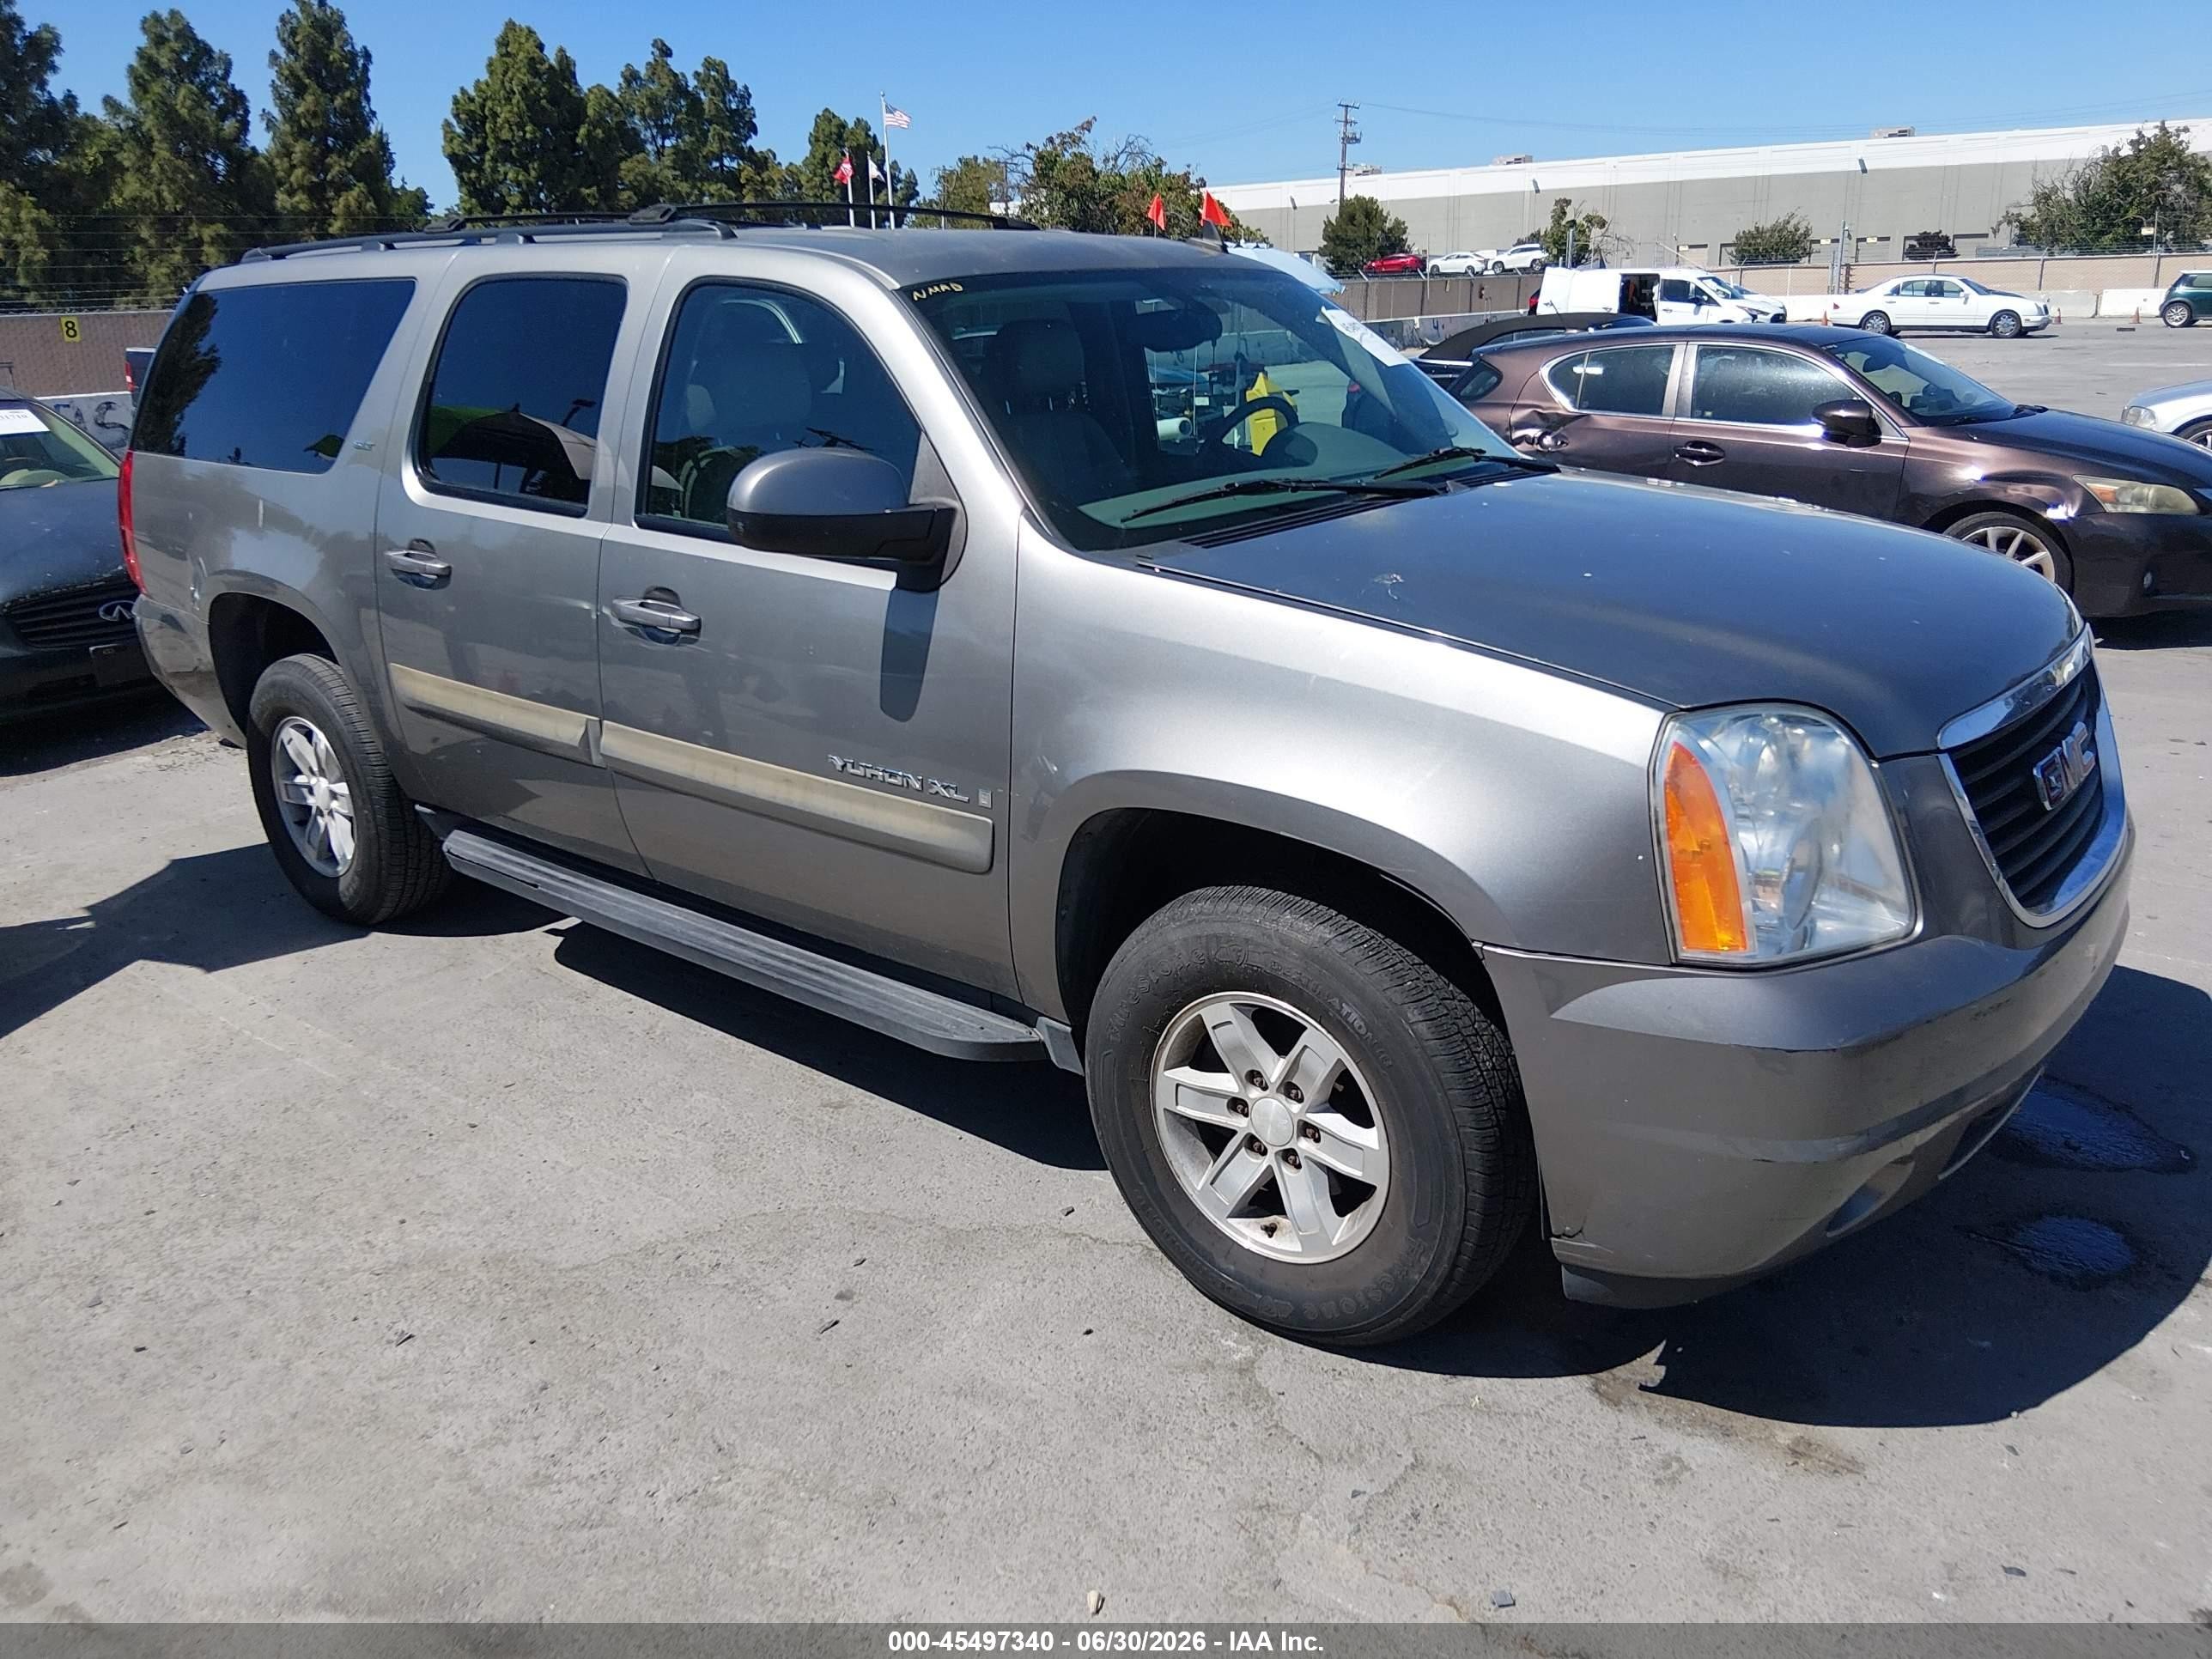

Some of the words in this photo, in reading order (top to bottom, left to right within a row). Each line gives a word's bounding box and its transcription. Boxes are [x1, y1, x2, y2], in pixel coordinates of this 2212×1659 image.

[64, 320, 77, 338] 8
[828, 754, 923, 791] YUKON
[927, 778, 969, 803] XL
[2033, 721, 2096, 811] GMC
